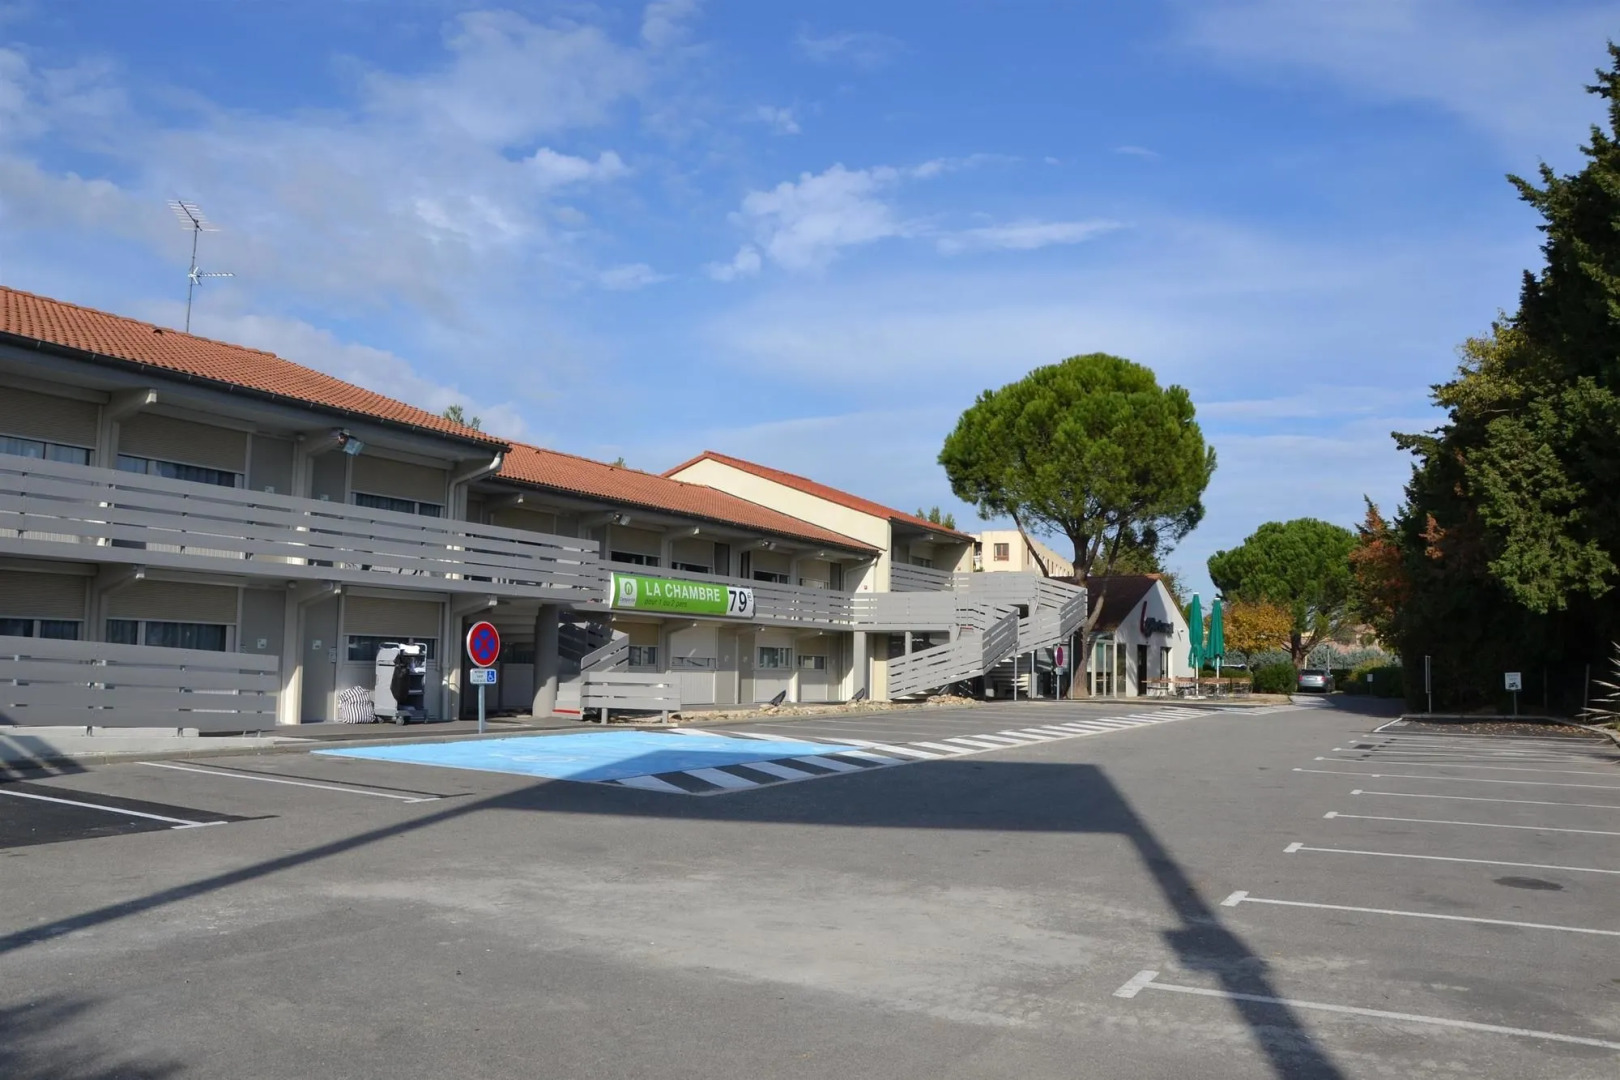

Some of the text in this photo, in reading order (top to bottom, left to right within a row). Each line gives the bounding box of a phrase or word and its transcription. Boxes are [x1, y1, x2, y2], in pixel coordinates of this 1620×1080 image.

[645, 581, 721, 602] LA CHAMBRE
[729, 590, 747, 612] 79
